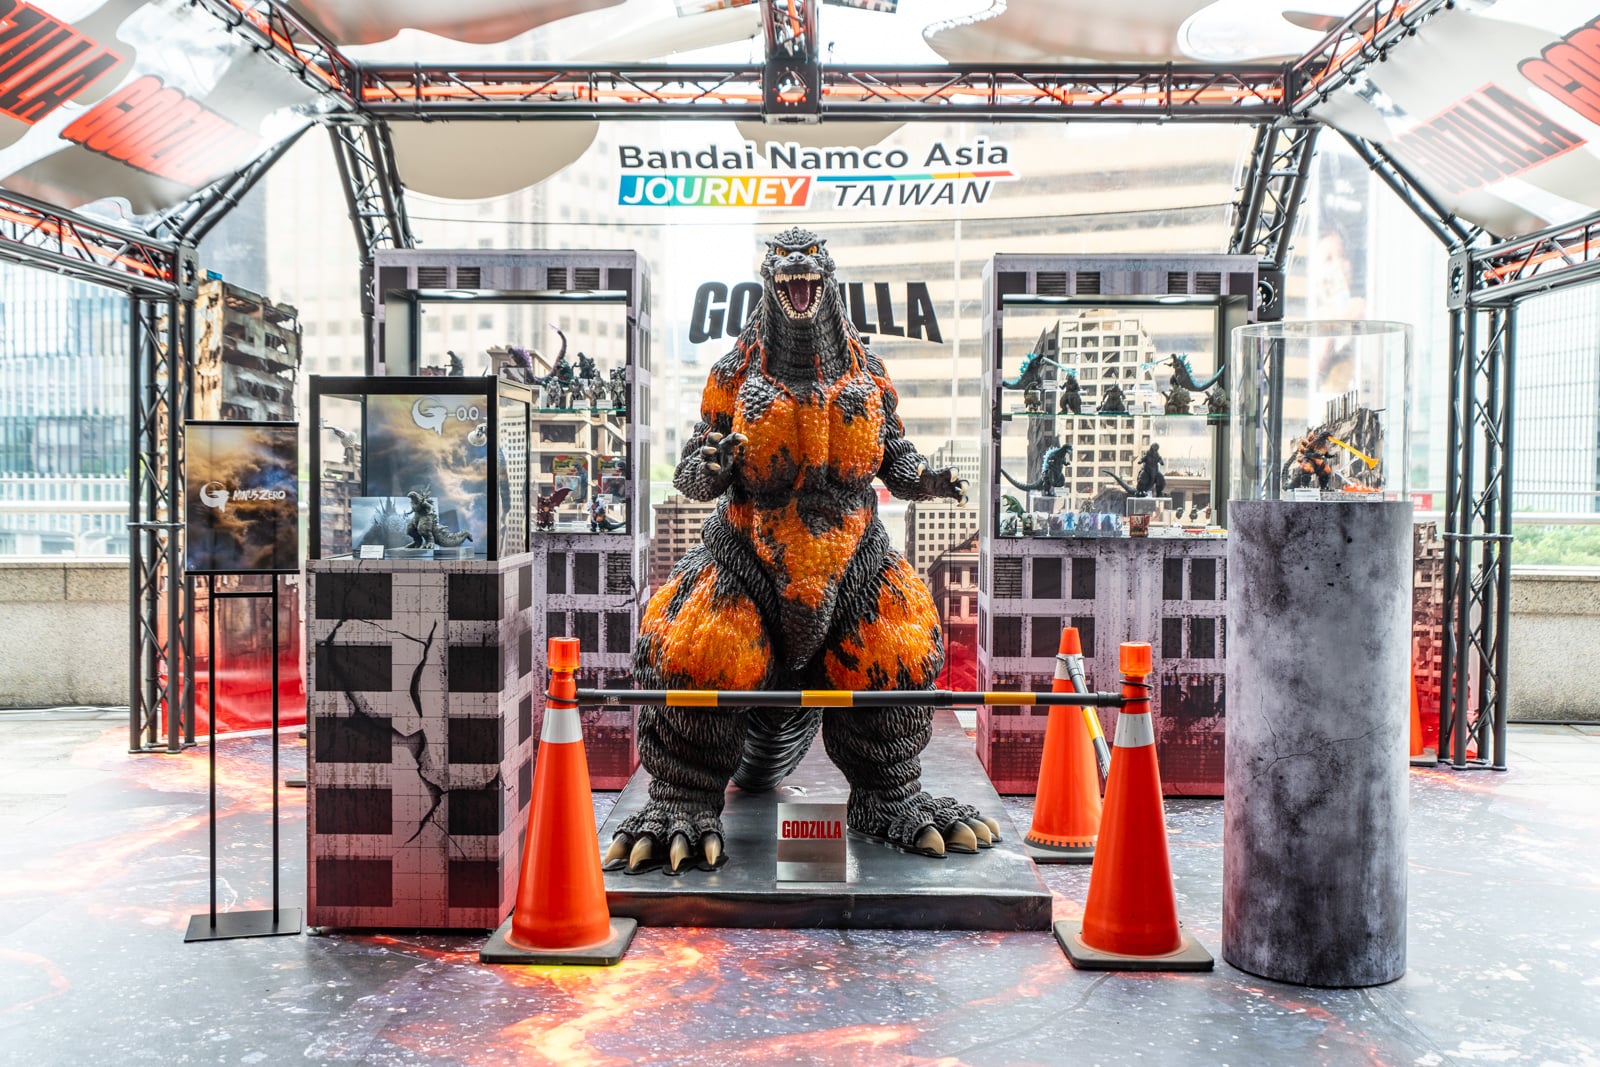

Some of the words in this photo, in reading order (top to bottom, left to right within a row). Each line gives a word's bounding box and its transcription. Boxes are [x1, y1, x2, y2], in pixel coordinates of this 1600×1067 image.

[1386, 82, 1587, 195] GODZILLA
[618, 144, 754, 170] Bandai
[771, 145, 909, 170] Namco
[923, 140, 1008, 167] Asia
[621, 177, 807, 205] JOURNEY
[834, 180, 991, 207] TAIWAN
[689, 281, 944, 344] GOLLA
[258, 488, 286, 501] ZERO
[781, 820, 843, 839] GODZILLA
